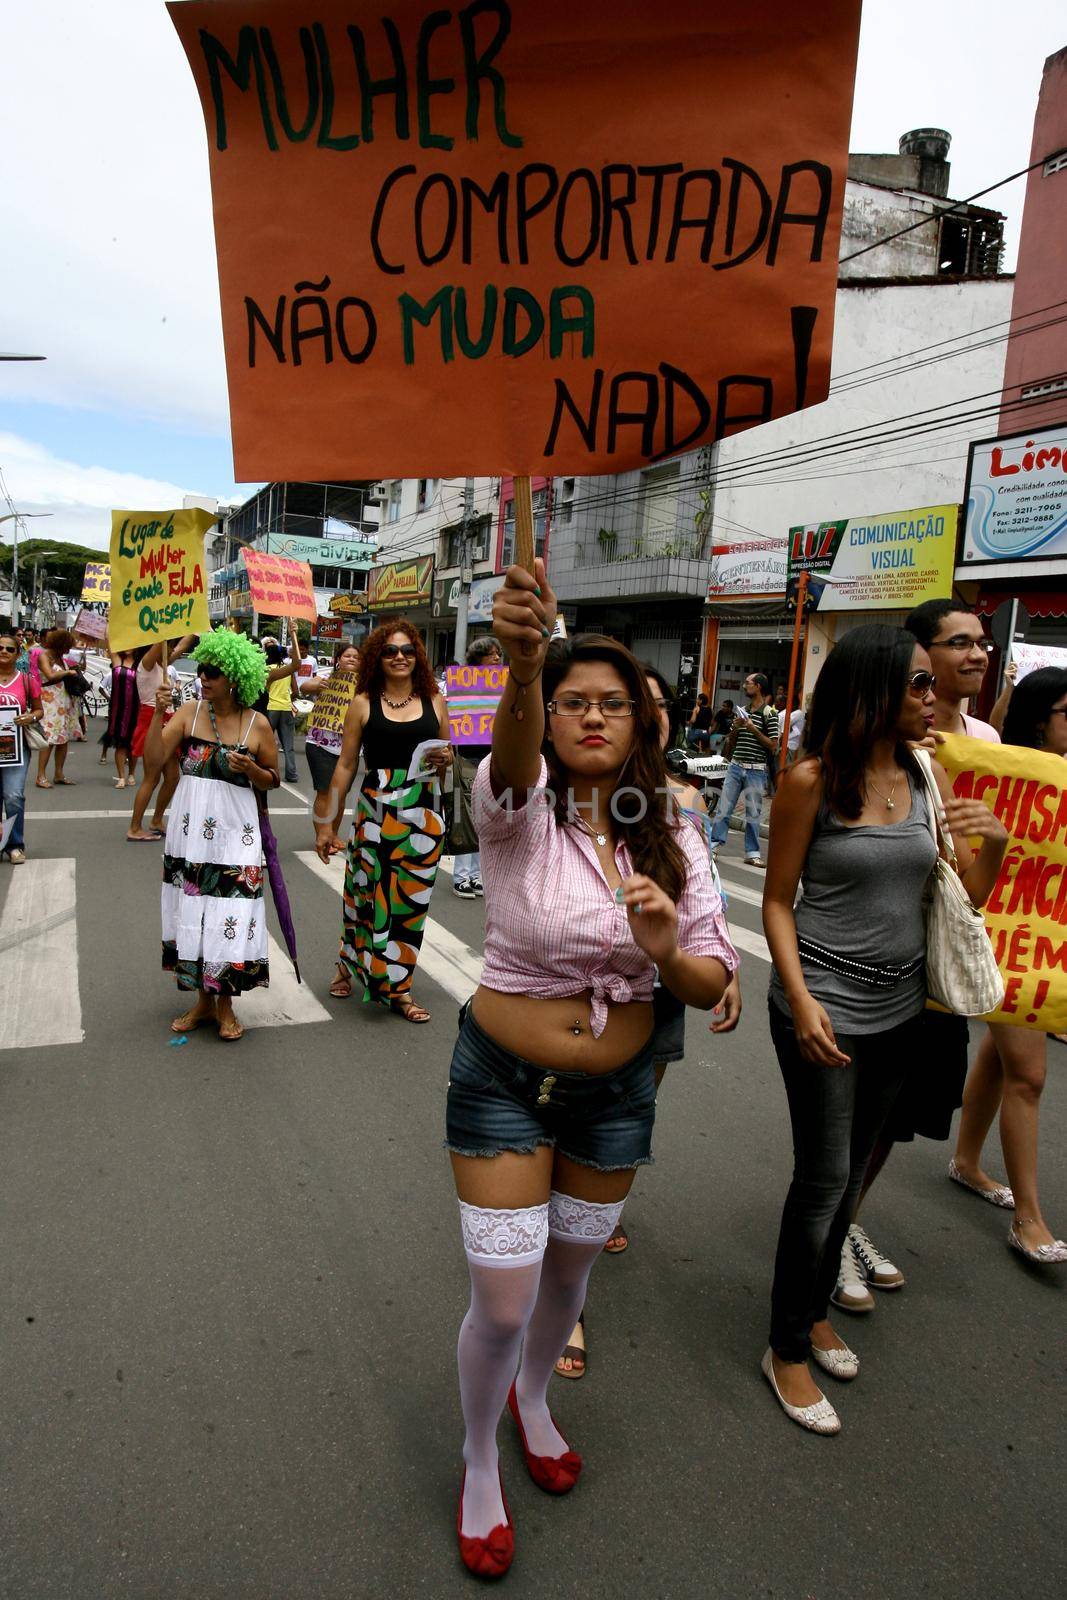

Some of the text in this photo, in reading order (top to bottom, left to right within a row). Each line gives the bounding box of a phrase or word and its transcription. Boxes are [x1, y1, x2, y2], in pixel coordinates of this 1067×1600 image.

[199, 1, 524, 152] MULHER
[370, 158, 833, 275] COMPORTADA
[245, 275, 595, 367] NÃO MUDA
[989, 440, 1067, 478] Lim
[119, 512, 175, 558] Lugar de
[791, 526, 837, 562] LUZ
[849, 514, 945, 546] COMUNICAÇÃO
[814, 559, 831, 568] DIGITAL
[871, 548, 916, 570] VISUAL
[122, 564, 204, 606] é onde ELA
